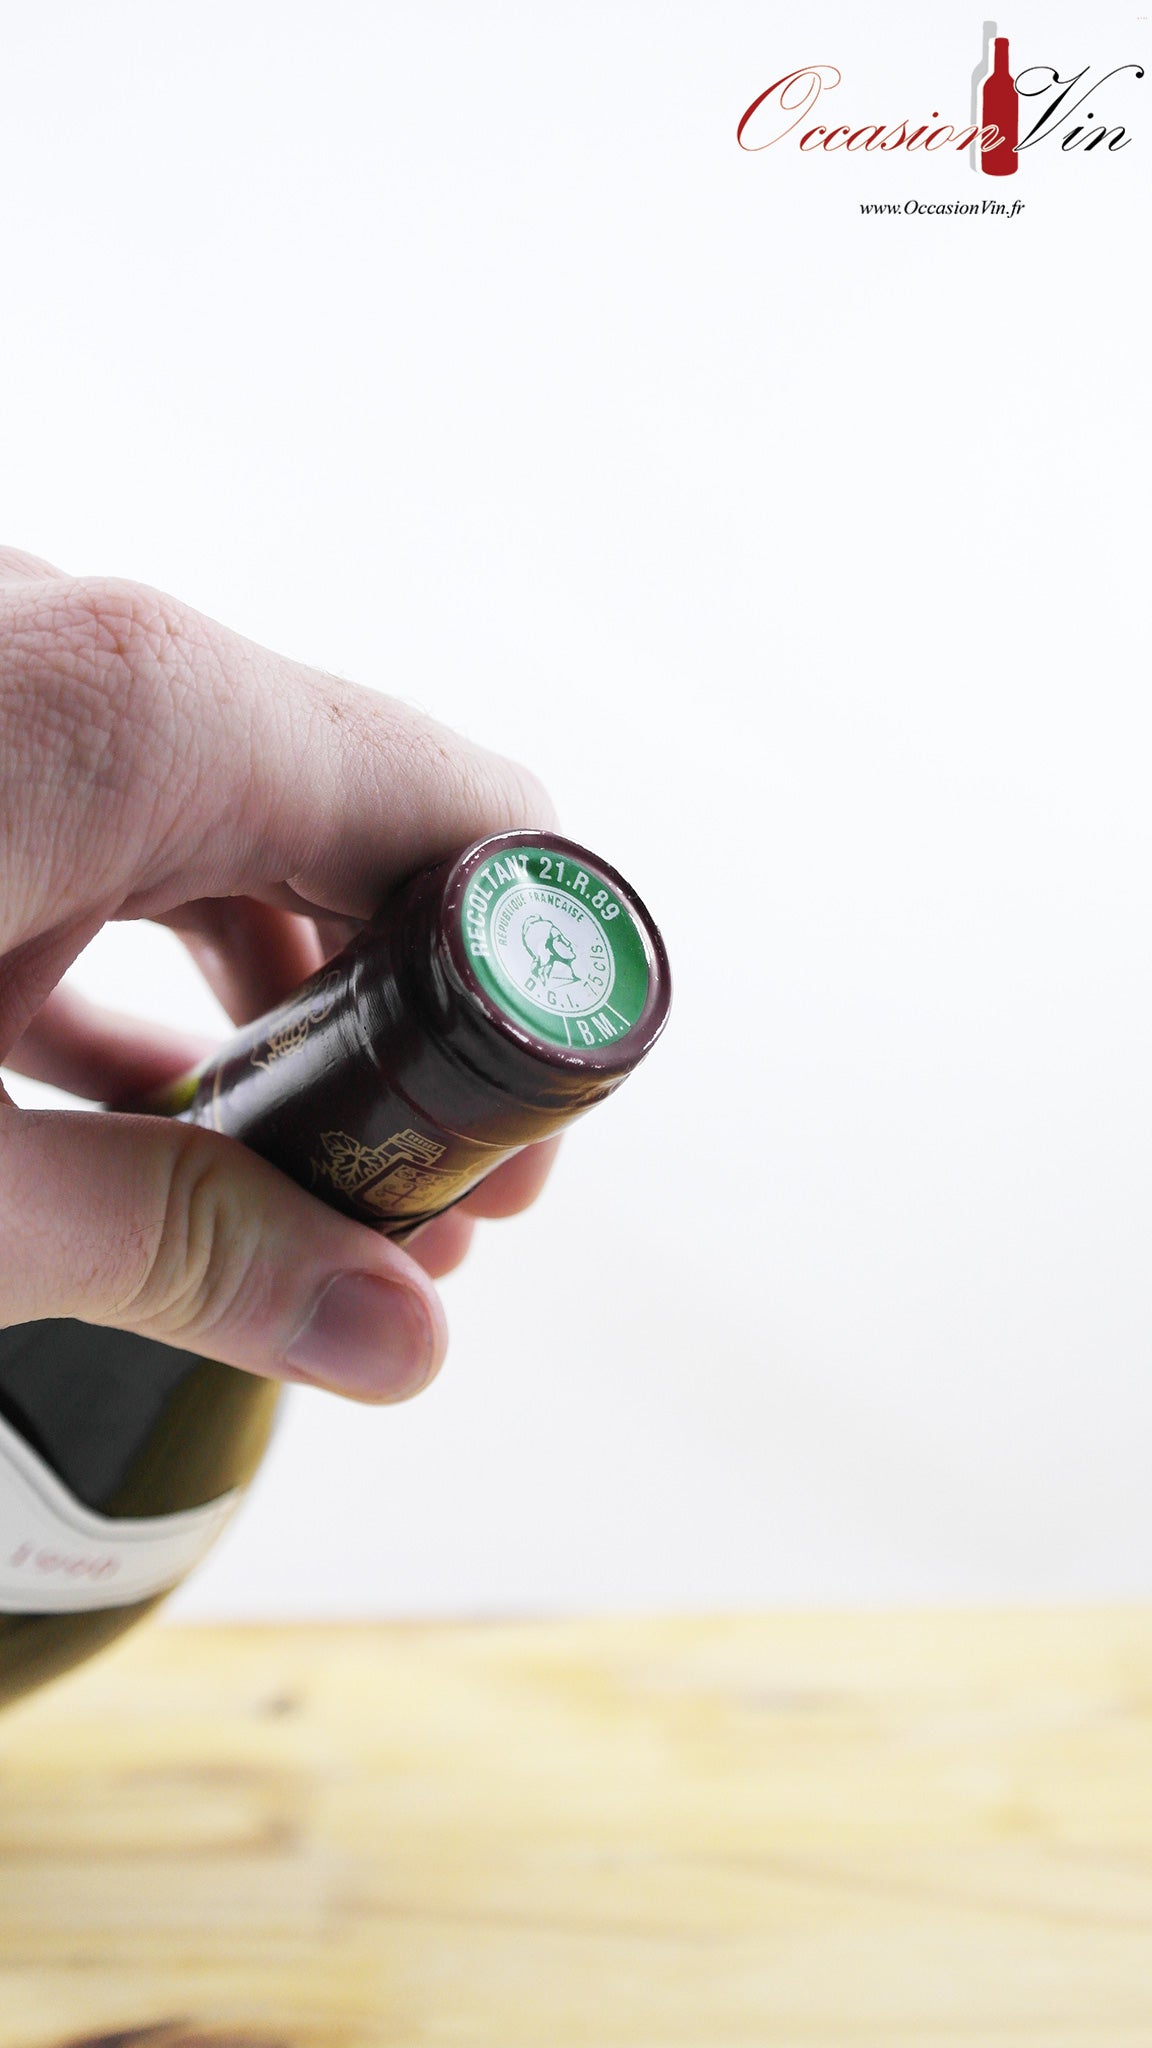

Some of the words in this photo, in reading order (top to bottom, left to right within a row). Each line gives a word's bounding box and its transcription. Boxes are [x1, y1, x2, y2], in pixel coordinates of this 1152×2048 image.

[467, 854, 529, 956] RECOLTANT
[539, 857, 620, 921] 21.R.89
[576, 1012, 624, 1045] B.M.
